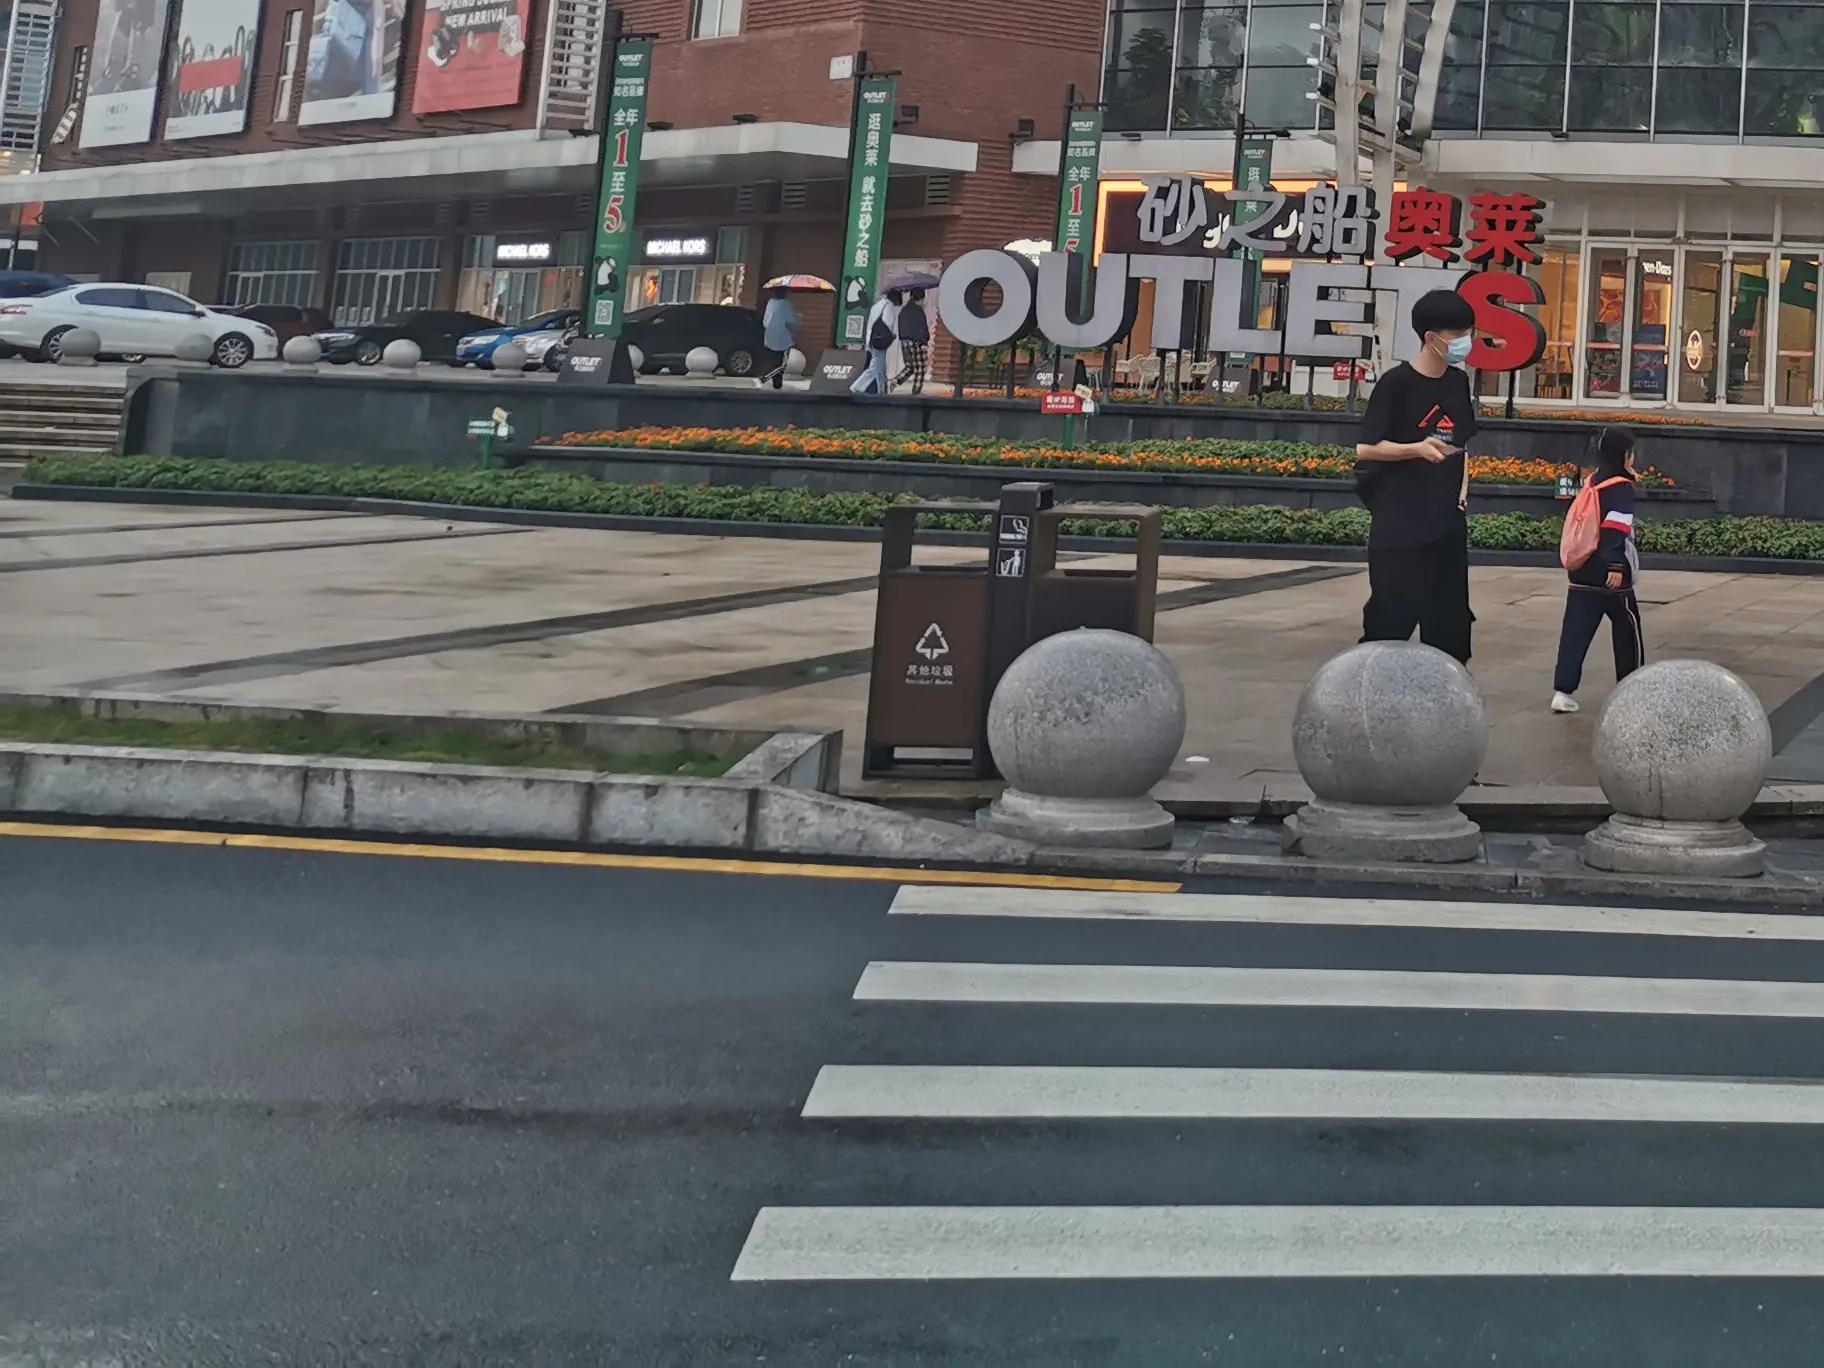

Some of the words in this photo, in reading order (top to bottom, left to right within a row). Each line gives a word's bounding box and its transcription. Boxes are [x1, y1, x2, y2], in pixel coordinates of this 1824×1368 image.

[445, 13, 466, 28] NEW
[467, 6, 508, 26] ARRIVAL
[614, 107, 640, 126] 全年
[1068, 166, 1091, 181] 全年
[1137, 175, 1540, 265] 砂之船奥莱
[938, 247, 1540, 372] OUTLETS
